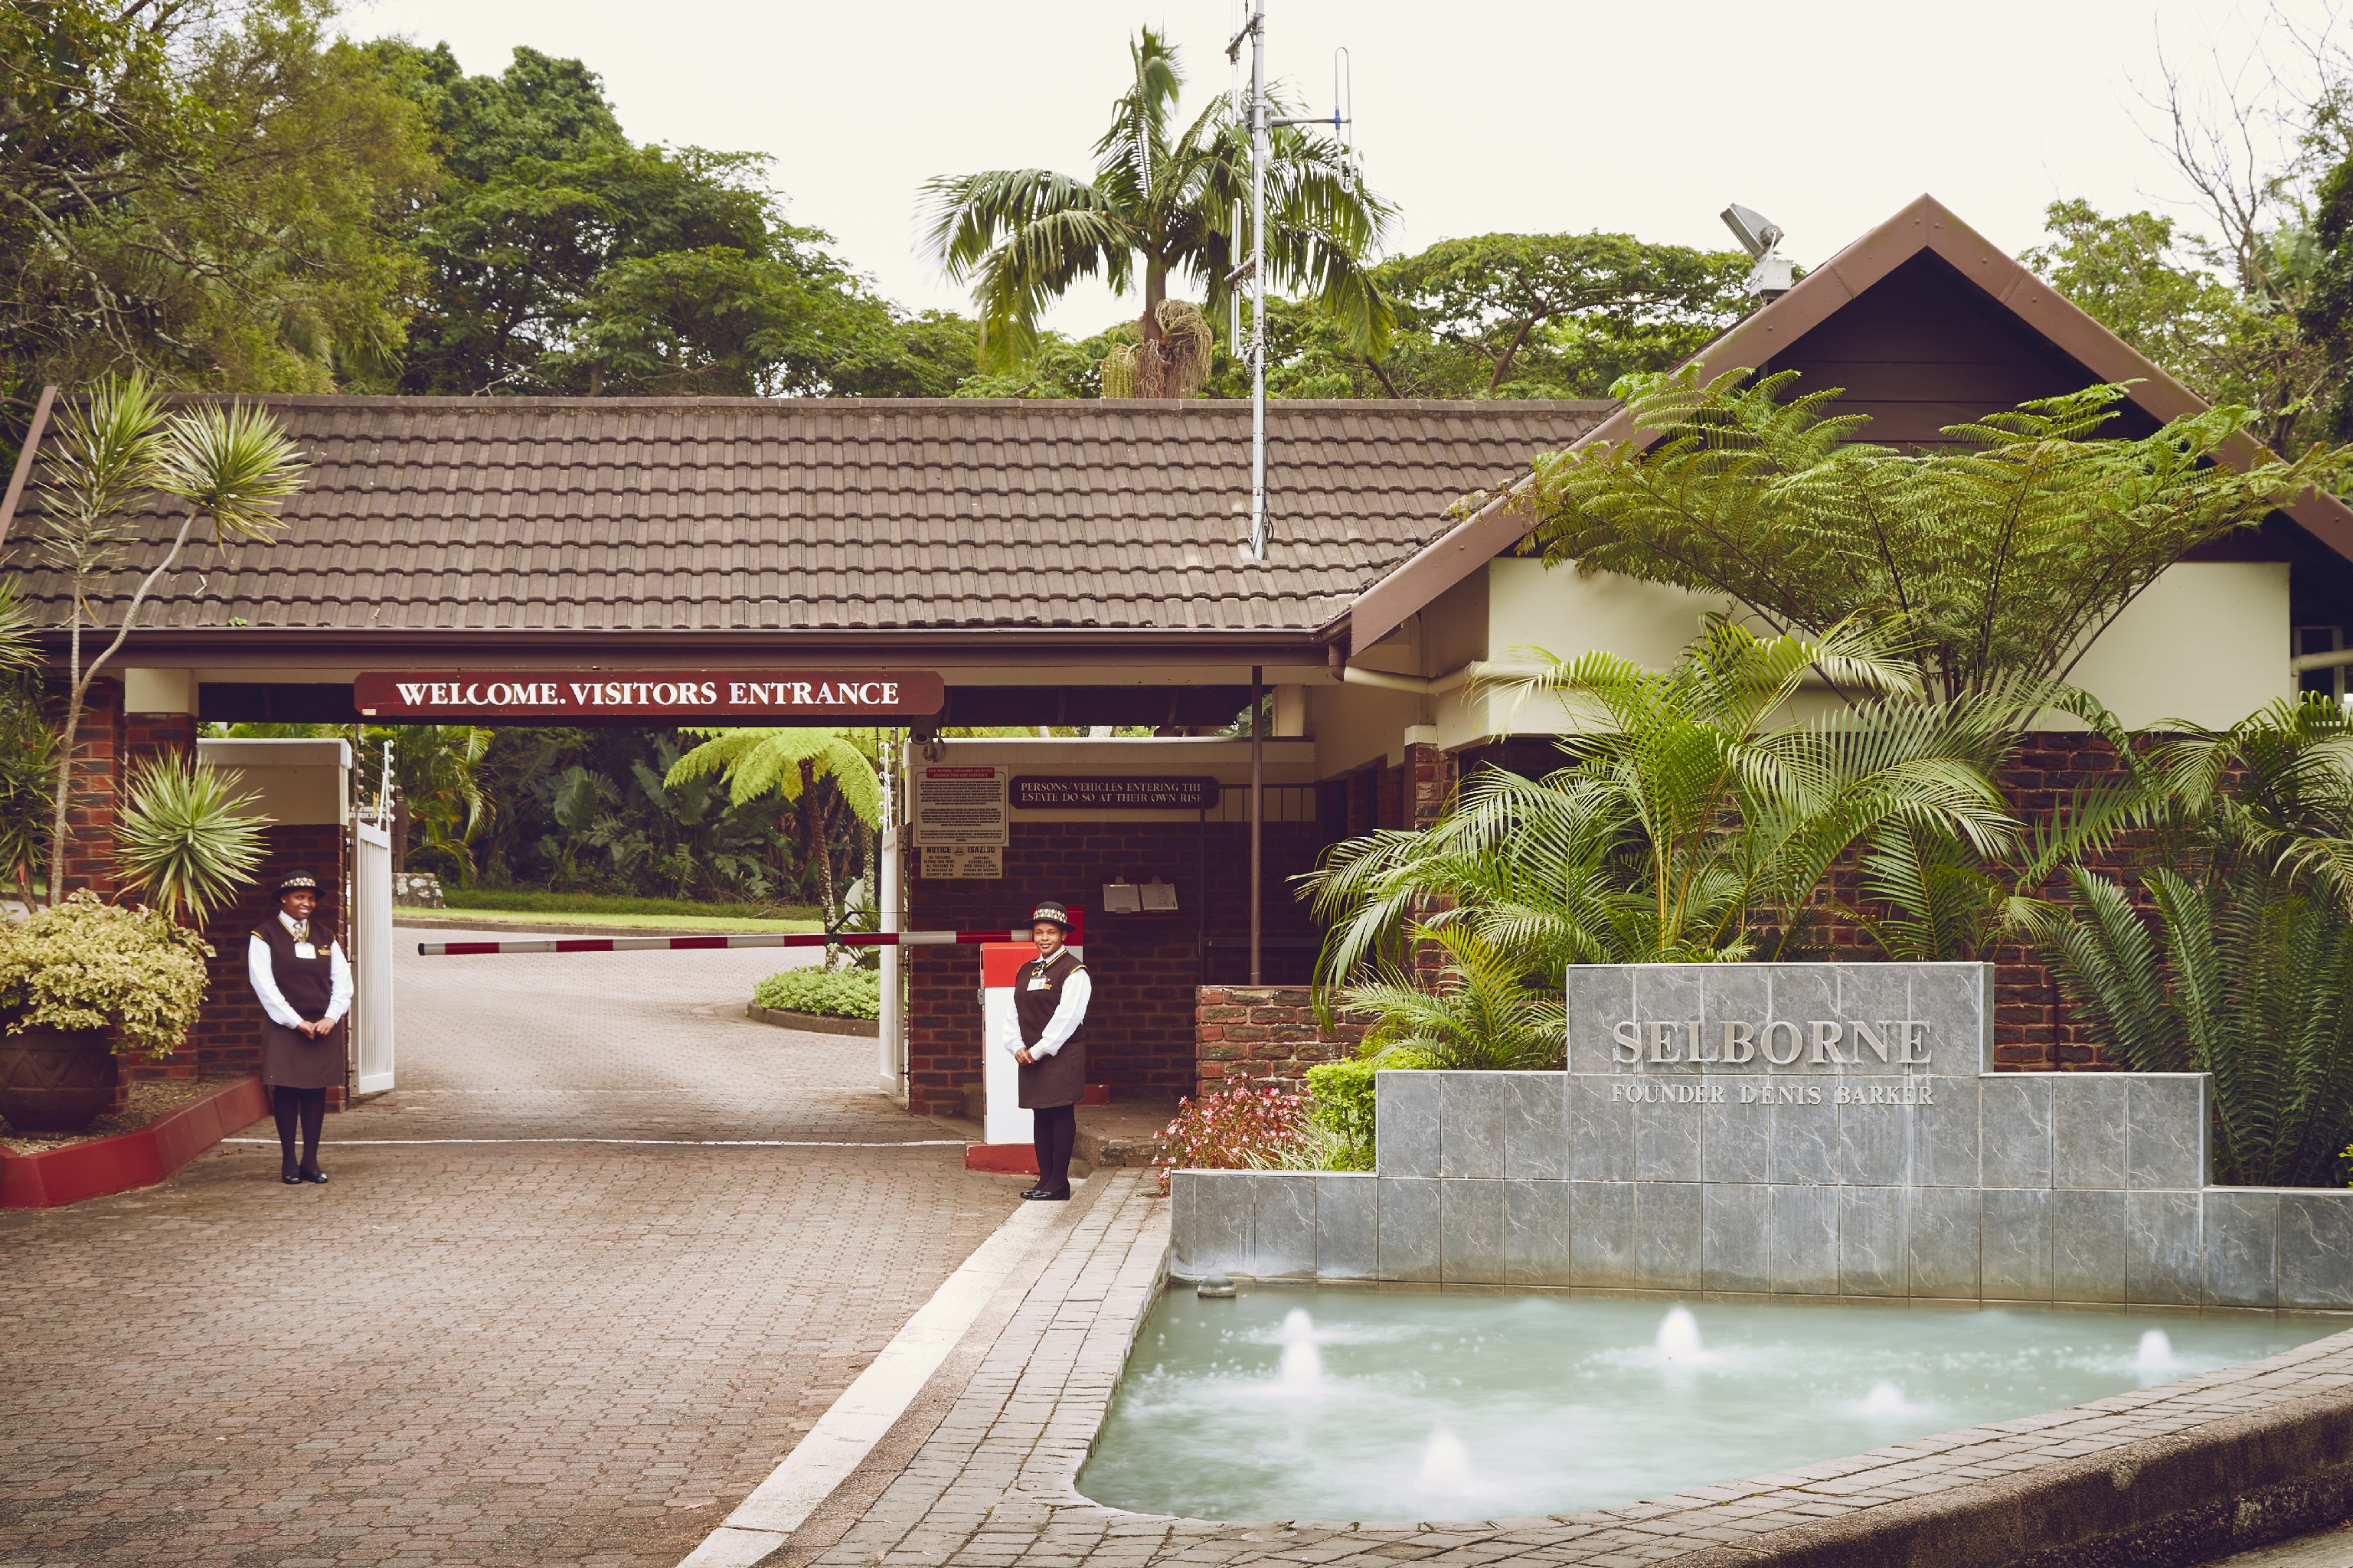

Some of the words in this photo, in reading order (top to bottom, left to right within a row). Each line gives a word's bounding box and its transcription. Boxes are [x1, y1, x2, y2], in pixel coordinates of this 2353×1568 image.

[572, 681, 717, 706] VISITORS
[728, 681, 900, 705] ENTRANCE
[1021, 792, 1058, 802] ESTATE
[1062, 793, 1079, 802] DO
[1081, 793, 1095, 802] SO
[1099, 793, 1113, 802] AT
[1116, 793, 1147, 802] THEIR
[1151, 793, 1176, 802] OWN
[1126, 782, 1178, 792] ENTERING
[1181, 783, 1206, 792] THI
[1611, 1020, 1933, 1065] SELBORNE
[1610, 1084, 1726, 1104] FOUNDER
[1739, 1085, 1822, 1105] DENIS
[1835, 1086, 1934, 1106] BARKER
